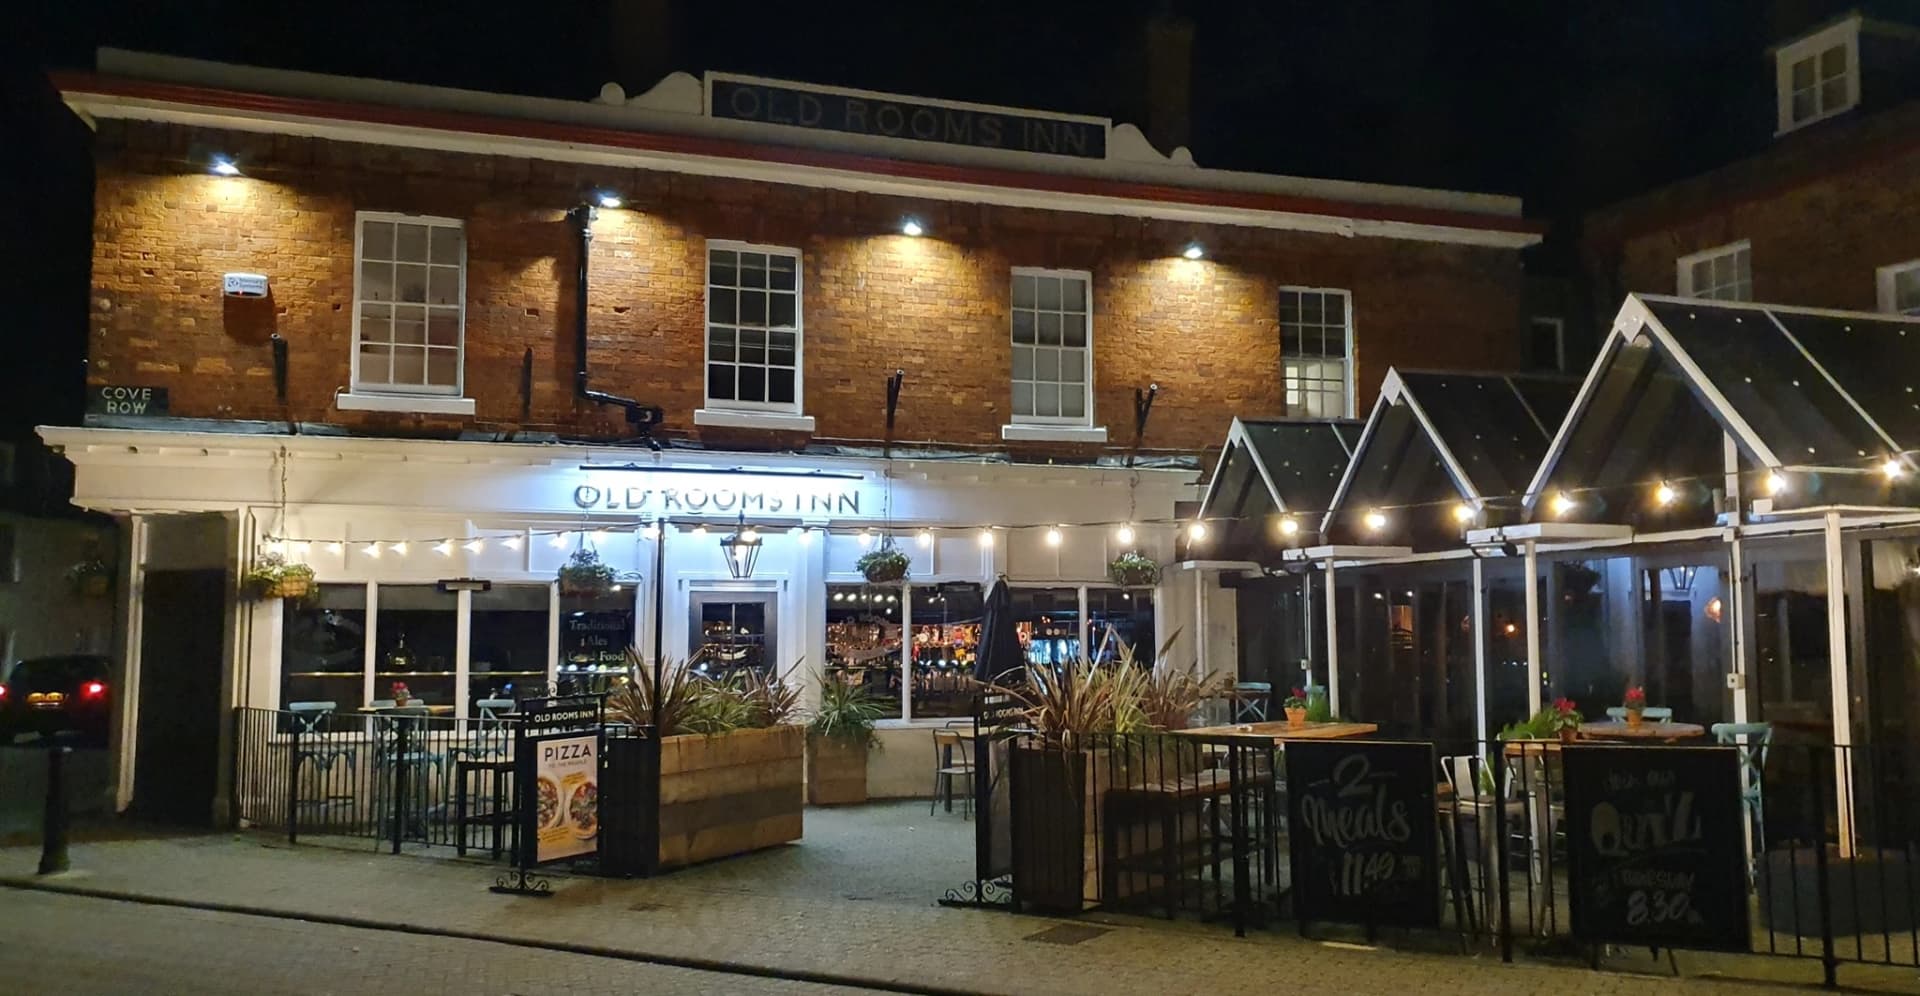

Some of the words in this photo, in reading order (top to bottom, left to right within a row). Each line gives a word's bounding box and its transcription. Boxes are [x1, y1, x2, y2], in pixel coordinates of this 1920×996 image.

[730, 86, 824, 127] OLD
[845, 98, 1003, 147] ROOMS
[1022, 117, 1090, 155] INN
[101, 386, 152, 400] COVE
[106, 400, 147, 415] ROW
[573, 484, 648, 510] OLD
[663, 487, 784, 513] ROOMS
[794, 489, 860, 515] INN
[600, 650, 625, 661] Food
[534, 713, 551, 723] OLD
[552, 710, 579, 721] ROOMS
[580, 710, 595, 719] INN
[544, 743, 592, 763] PIZZA
[1331, 752, 1373, 798] 2
